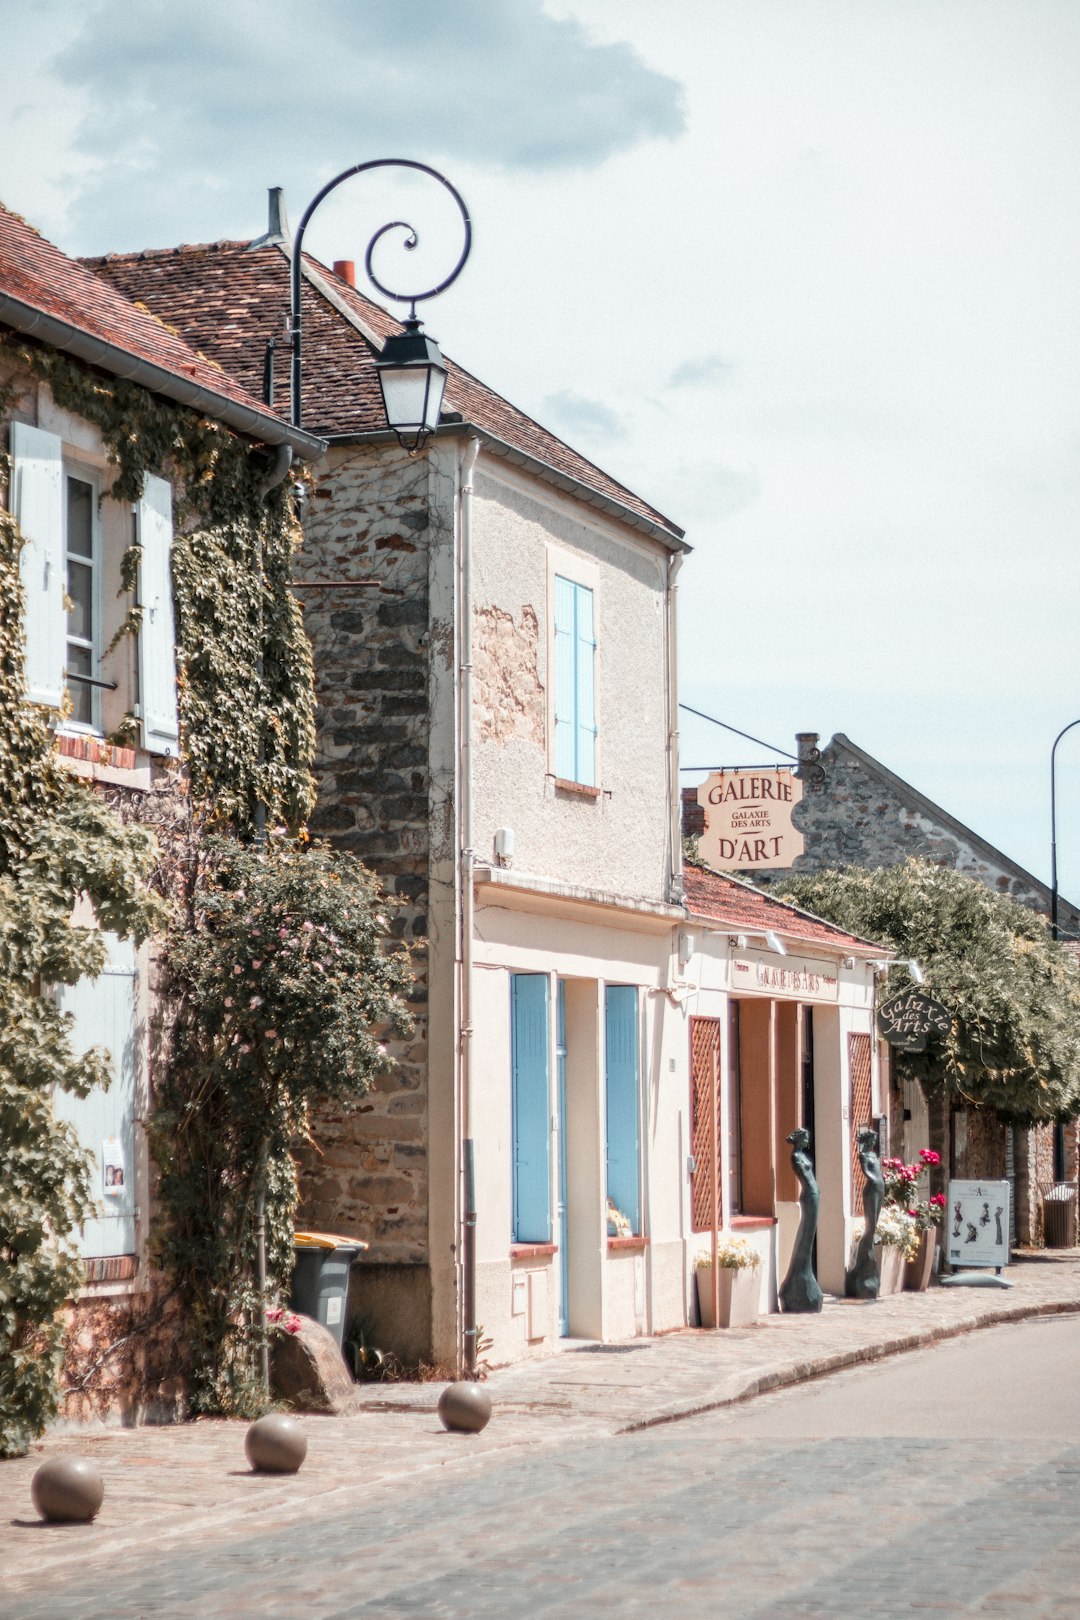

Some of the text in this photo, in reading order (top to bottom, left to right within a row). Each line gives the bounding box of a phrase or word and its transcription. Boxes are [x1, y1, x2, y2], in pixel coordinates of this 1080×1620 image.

[708, 778, 793, 805] GALERIE
[731, 811, 769, 820] GALAXIE
[731, 819, 771, 828] DES ARTS
[718, 836, 783, 862] D'ART
[881, 994, 949, 1031] Galaxie
[902, 1009, 920, 1020] des
[883, 1018, 931, 1034] Arts
